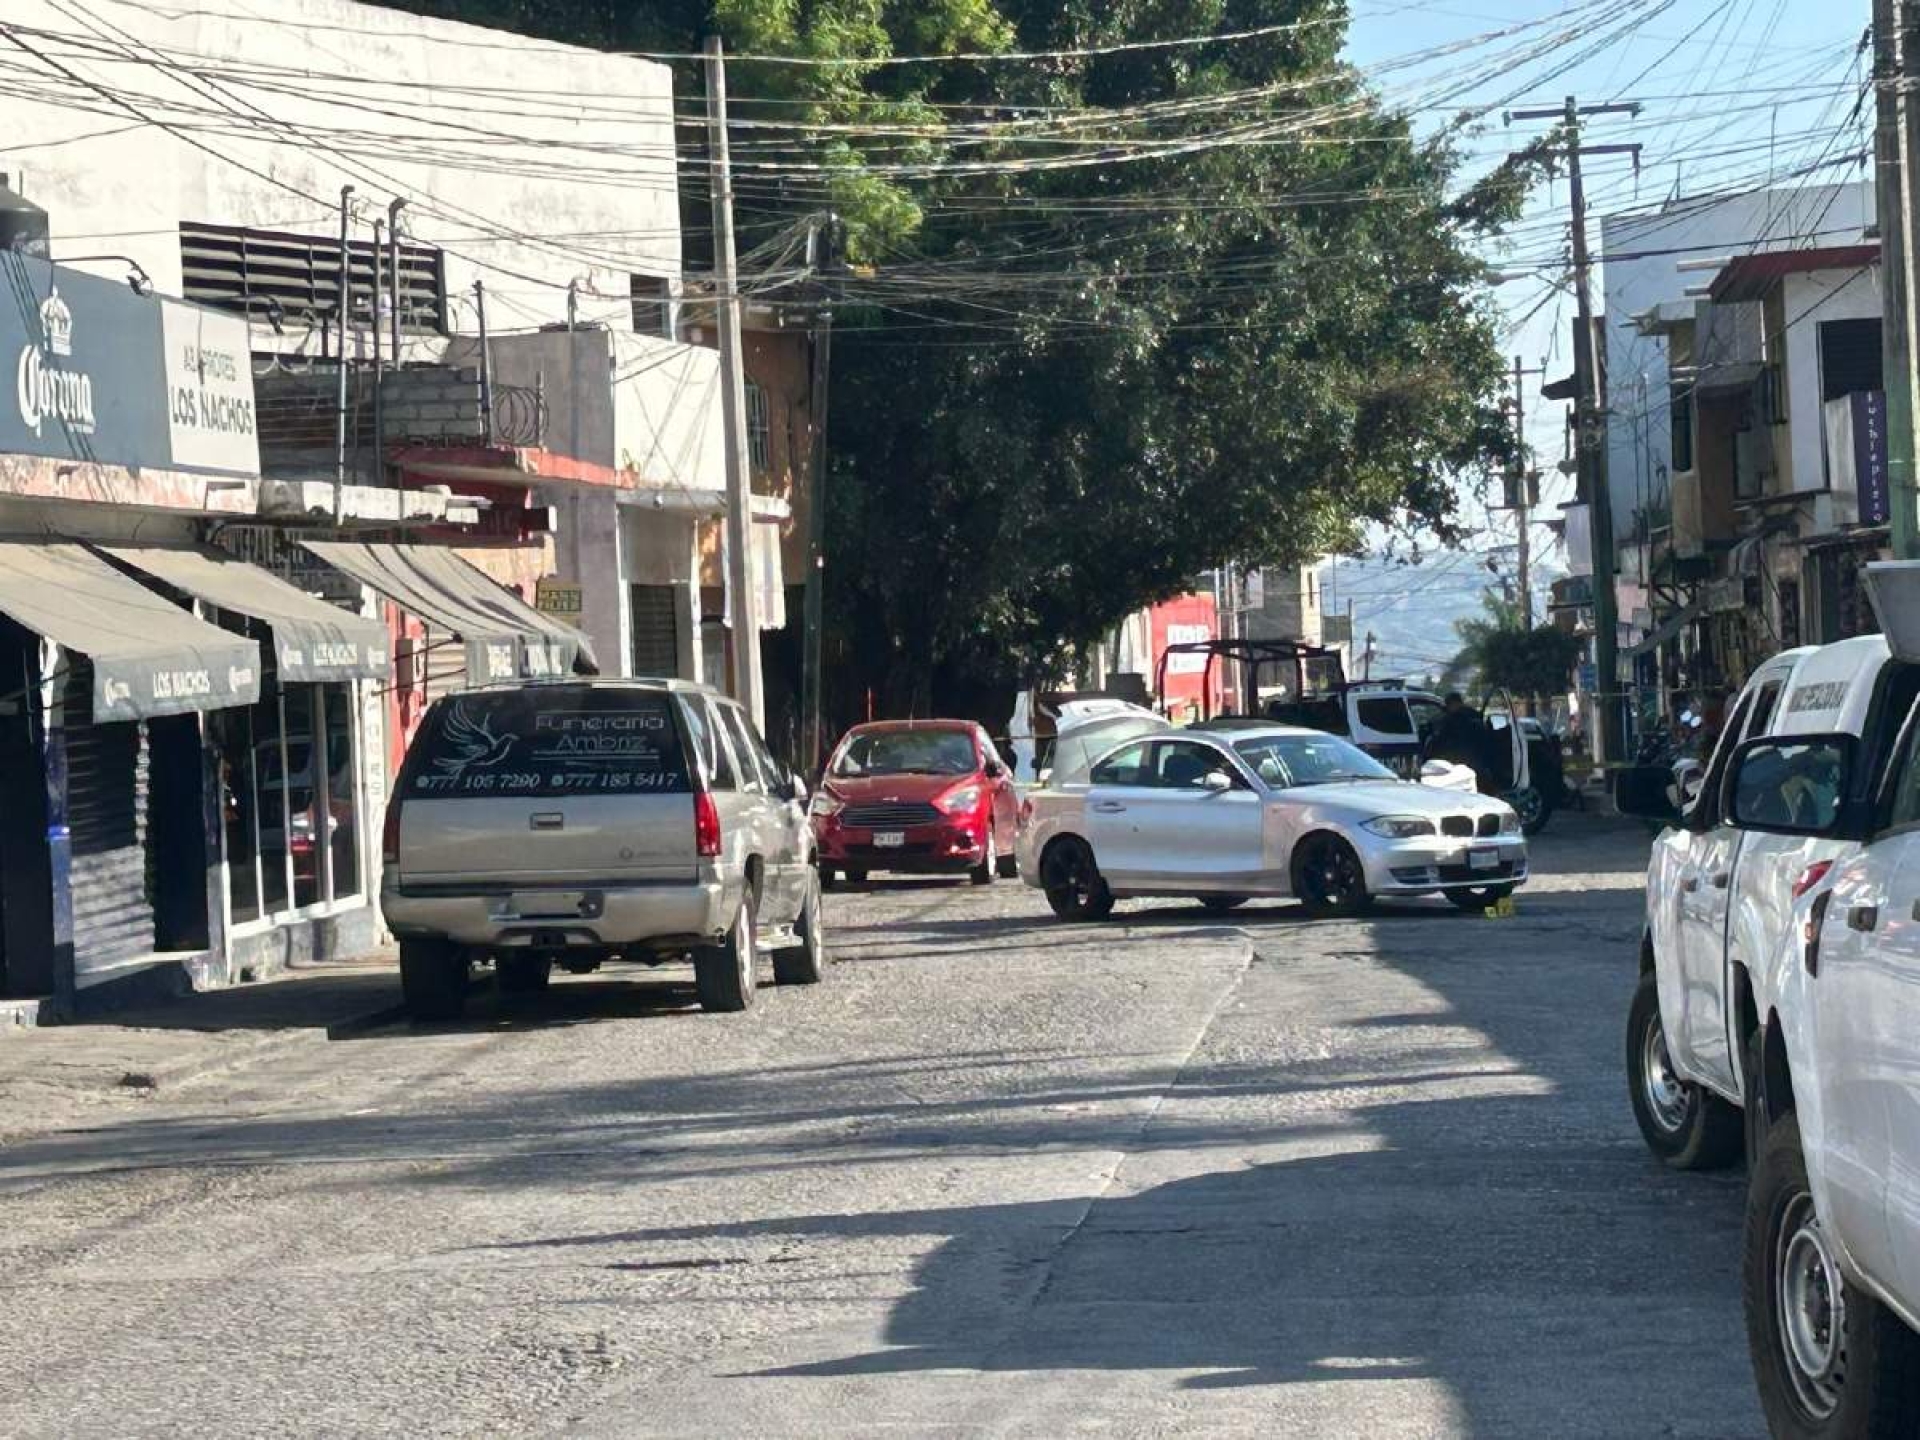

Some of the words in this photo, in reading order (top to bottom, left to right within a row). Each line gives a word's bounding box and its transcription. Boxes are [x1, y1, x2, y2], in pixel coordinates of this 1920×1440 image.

[17, 344, 97, 438] Corona
[170, 385, 197, 427] LOS
[200, 391, 253, 435] NACHOS
[153, 672, 172, 698] LOS
[535, 714, 665, 732] Funeraria
[556, 732, 648, 752] Ambriz
